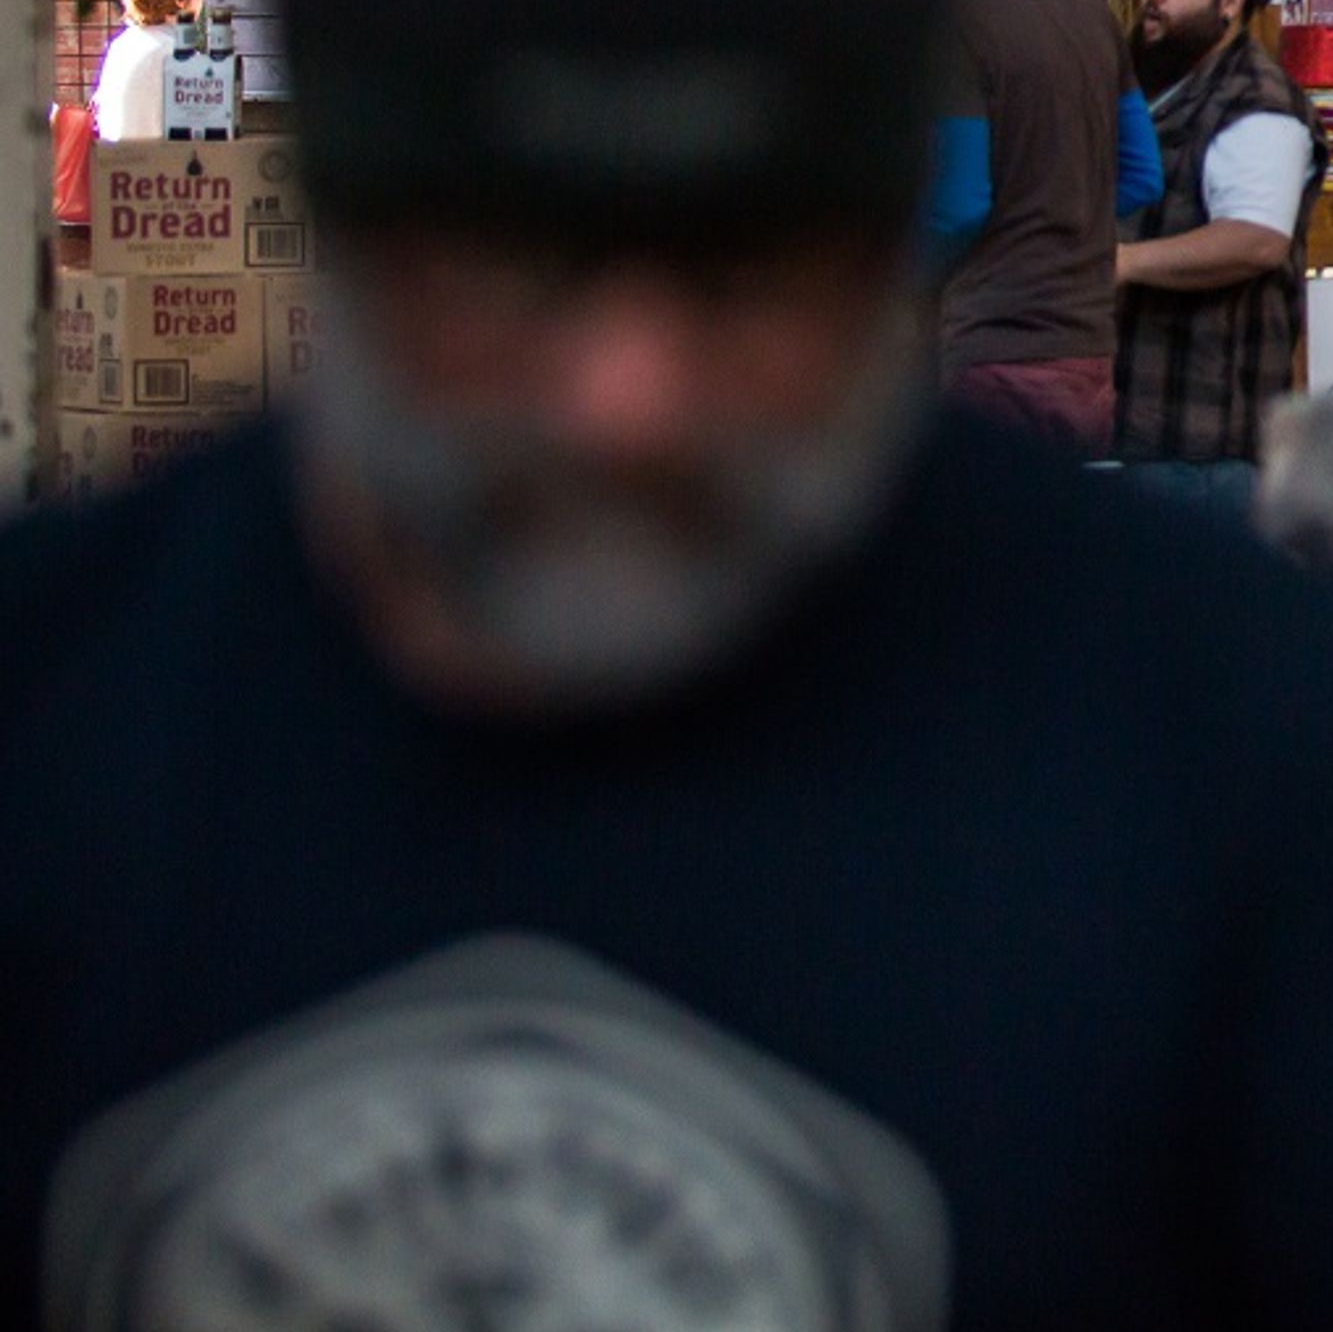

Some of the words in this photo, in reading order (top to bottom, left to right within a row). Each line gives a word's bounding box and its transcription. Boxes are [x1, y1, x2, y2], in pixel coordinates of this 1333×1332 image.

[174, 76, 225, 89] Return
[174, 90, 225, 105] Dread
[110, 171, 232, 201] Return
[111, 205, 232, 240] Dread
[153, 284, 237, 307] Return
[153, 309, 237, 336] Dread
